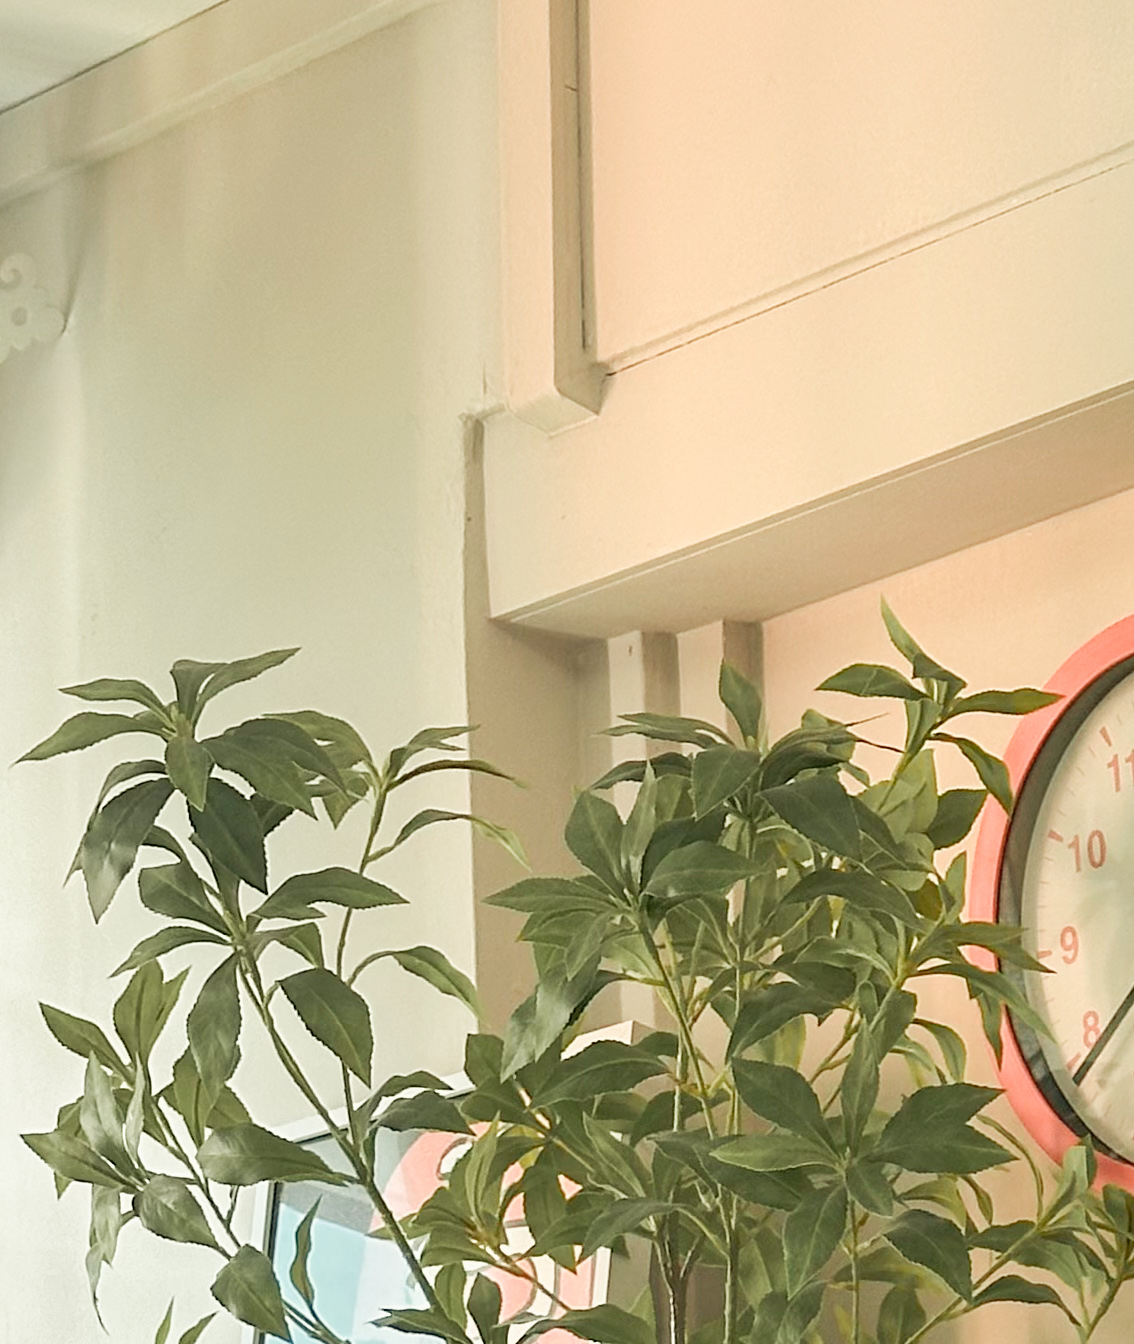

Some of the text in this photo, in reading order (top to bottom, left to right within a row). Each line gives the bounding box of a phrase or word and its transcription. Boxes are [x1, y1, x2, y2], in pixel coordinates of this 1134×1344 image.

[1067, 829, 1107, 875] 10
[1059, 926, 1079, 964] 9
[1082, 1010, 1101, 1050] 8
